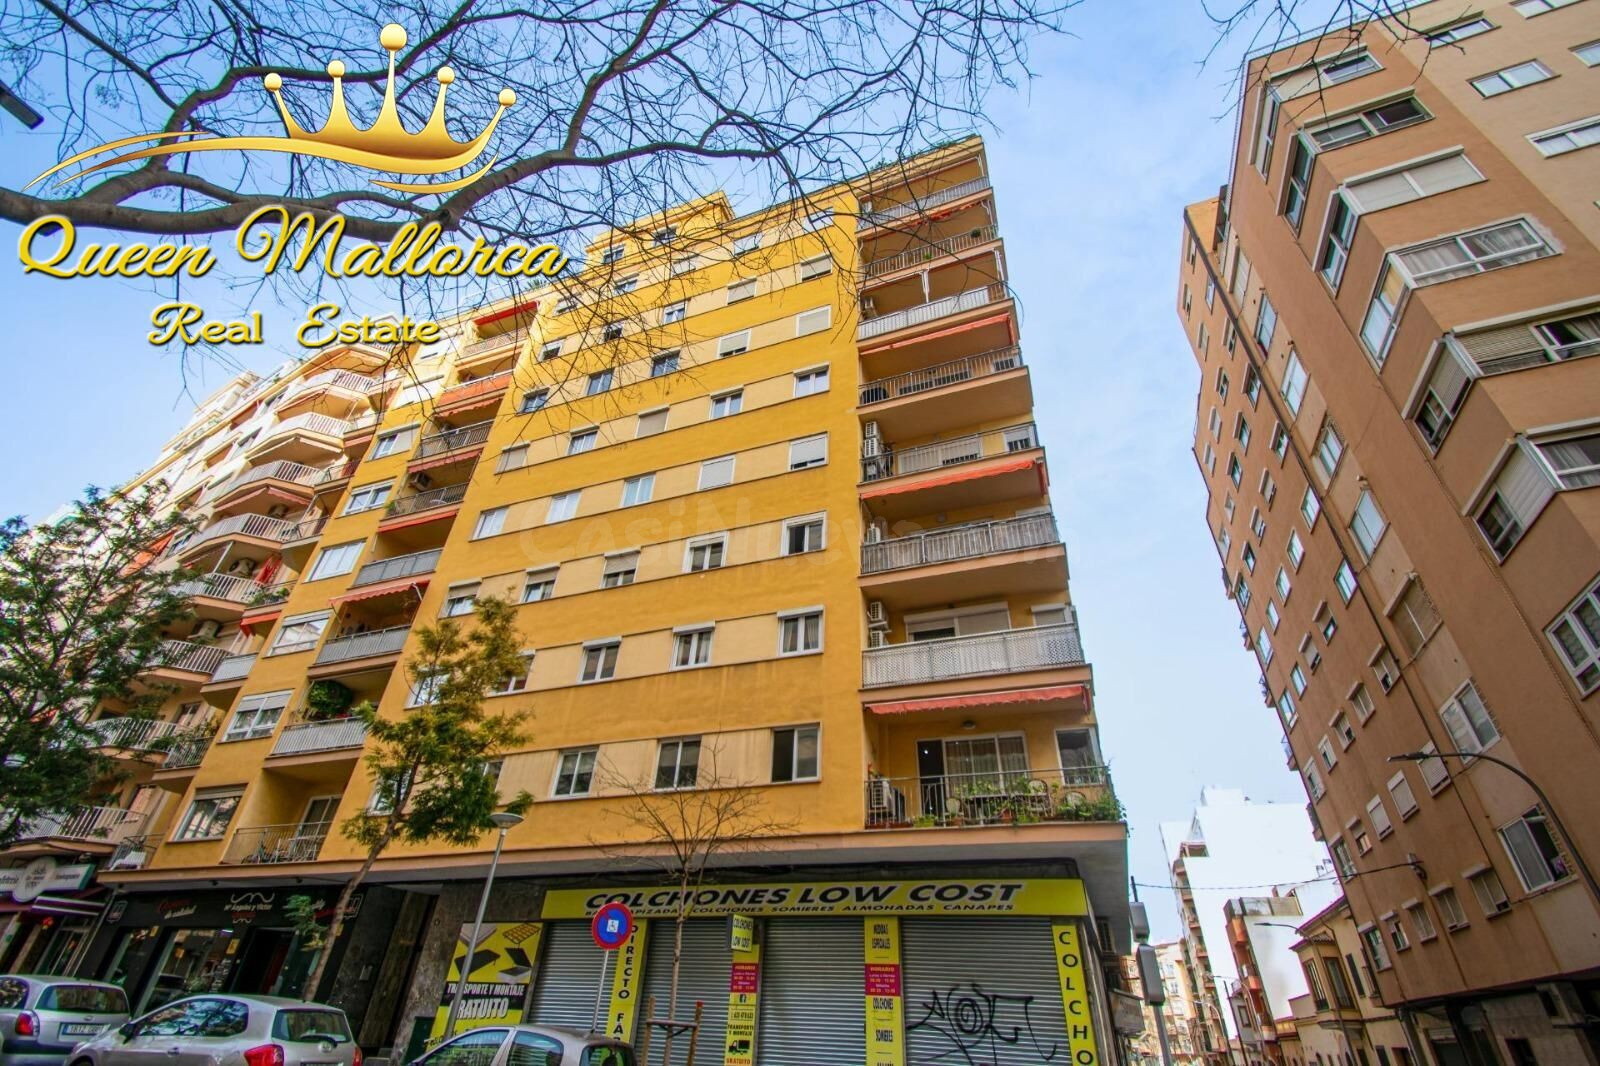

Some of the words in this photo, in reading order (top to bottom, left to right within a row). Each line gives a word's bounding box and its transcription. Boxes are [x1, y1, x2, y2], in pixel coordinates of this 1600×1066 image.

[586, 888, 791, 909] COLCHONES
[798, 886, 897, 904] LOW
[909, 884, 1022, 902] COST
[447, 983, 490, 995] TRASPORTE
[449, 997, 509, 1019] RATUITO
